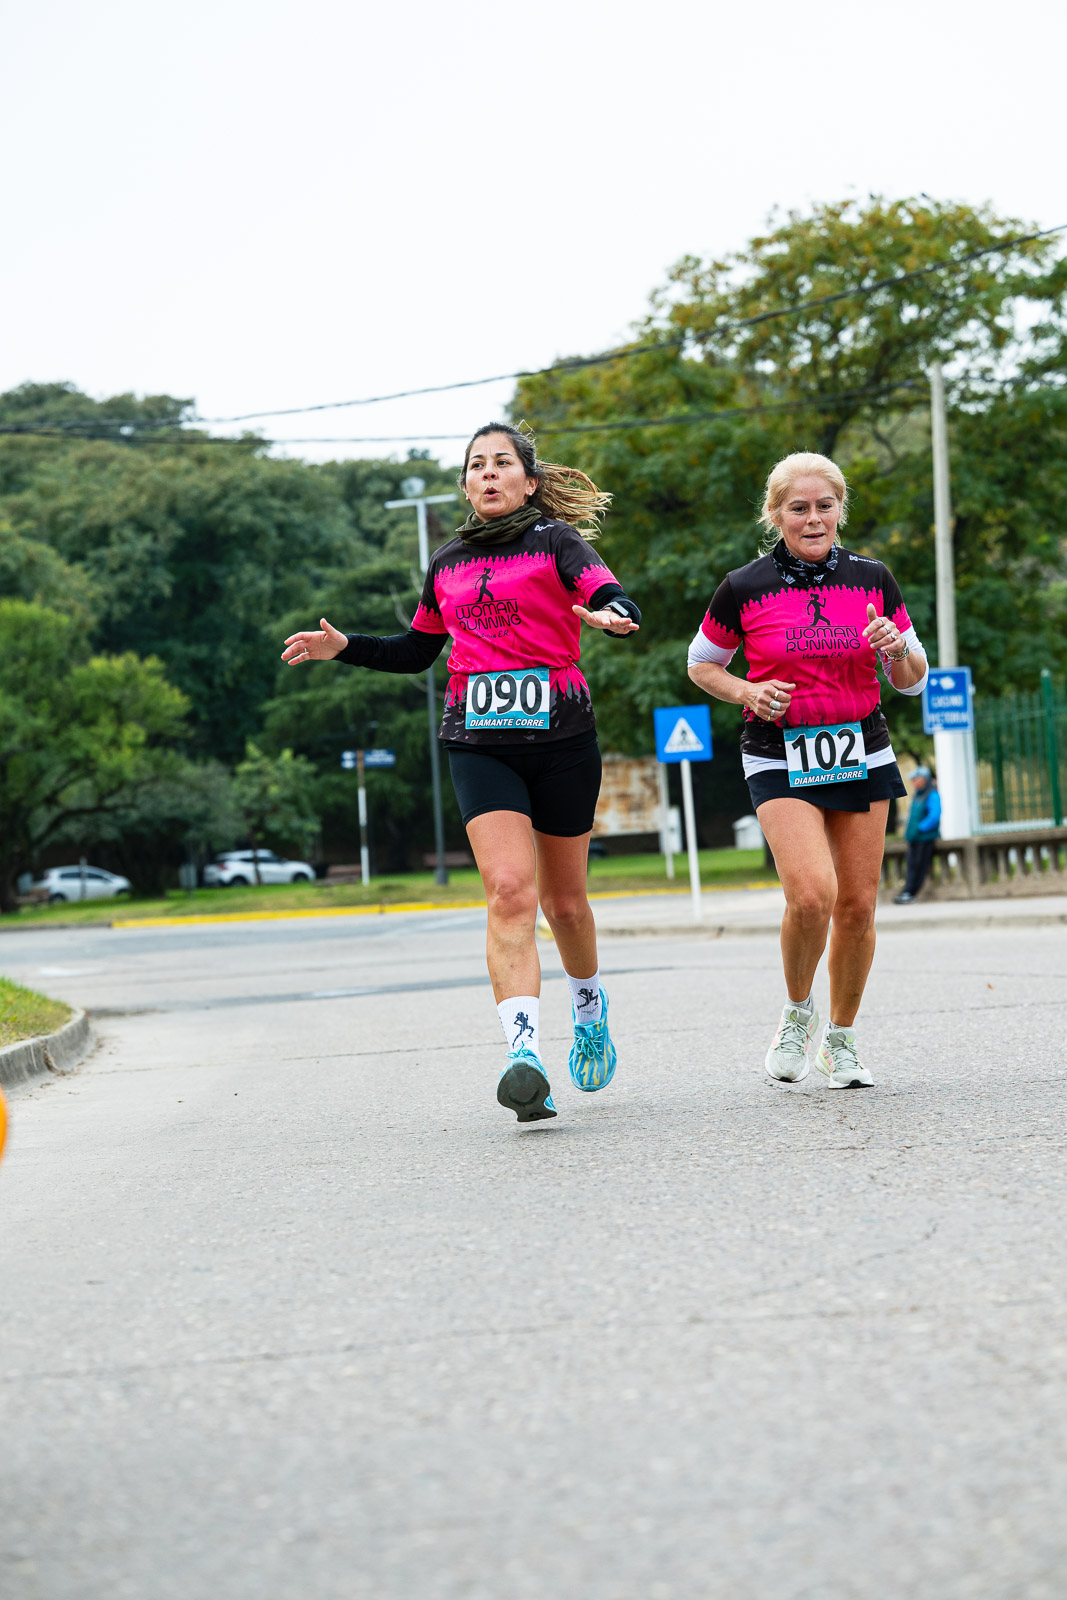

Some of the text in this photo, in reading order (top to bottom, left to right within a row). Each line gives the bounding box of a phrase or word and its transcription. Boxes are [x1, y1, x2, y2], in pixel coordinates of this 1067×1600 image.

[455, 600, 519, 620] WOMAN
[459, 614, 522, 631] RUNNING
[786, 627, 859, 641] WOMAN
[786, 638, 861, 653] RUNNING
[471, 673, 543, 717] 090
[469, 718, 546, 728] DIAMANTE CORRE
[791, 727, 860, 774] 102
[793, 769, 864, 786] DIAMANTE CORRE
